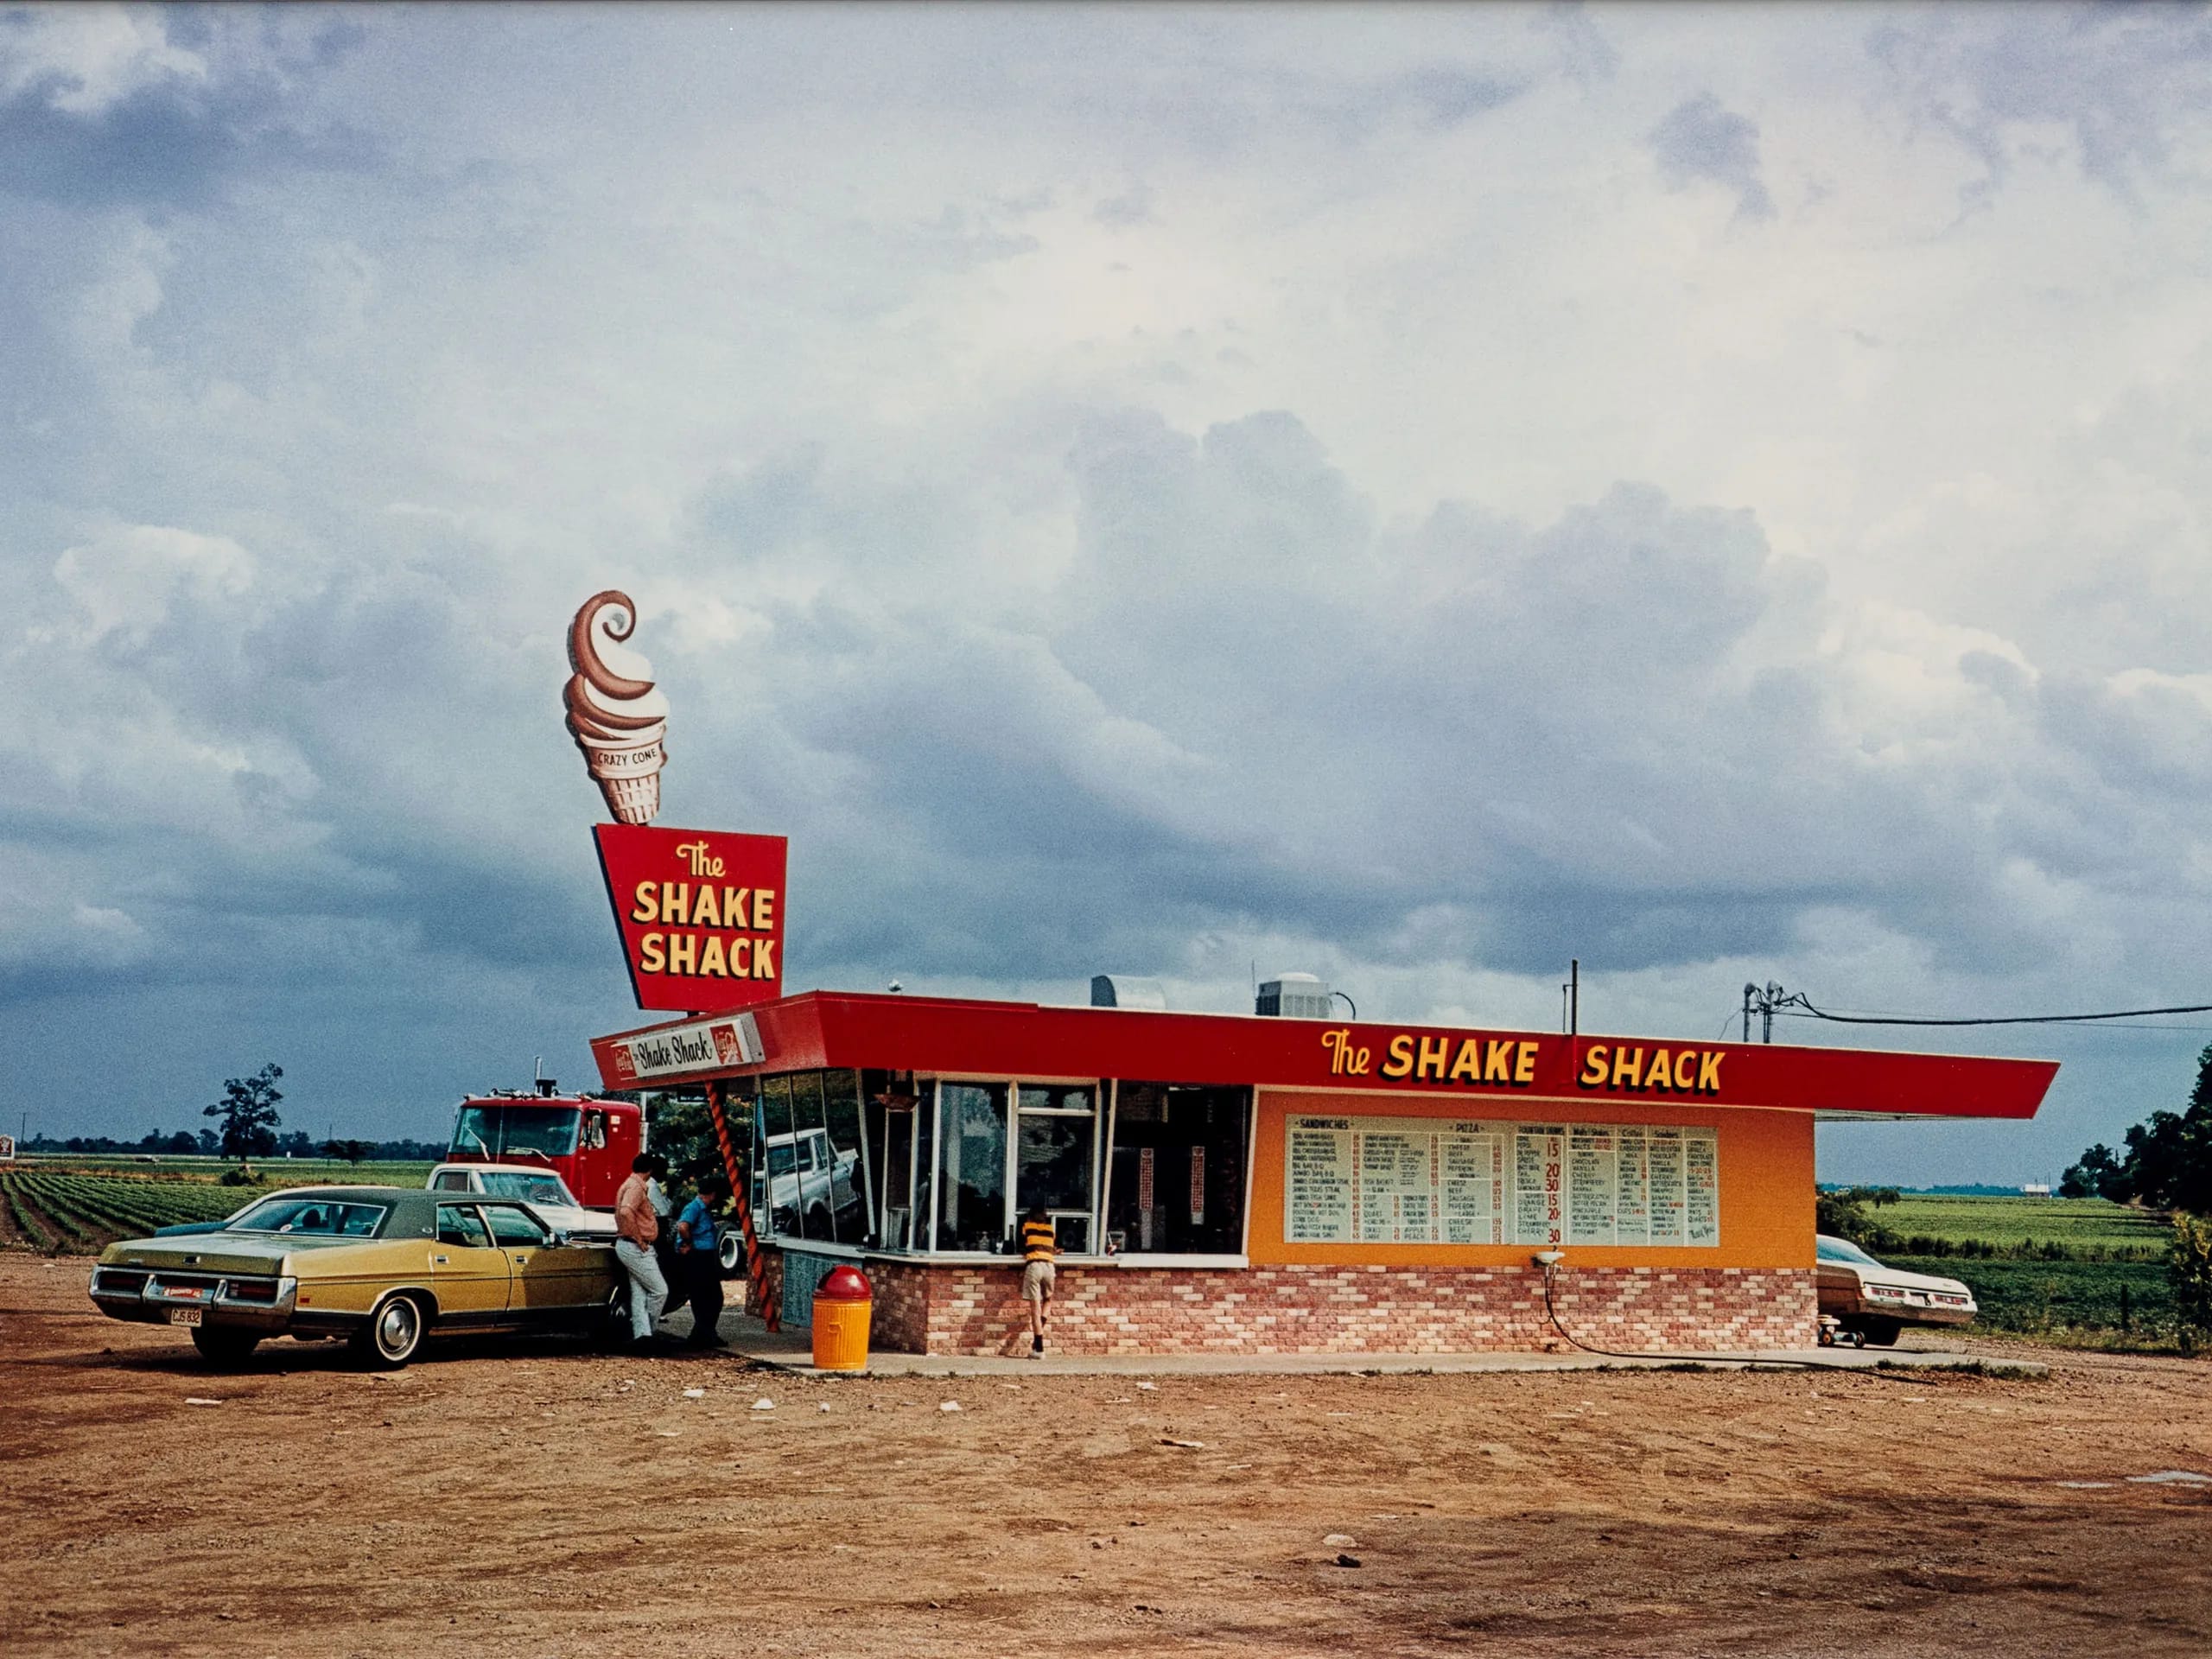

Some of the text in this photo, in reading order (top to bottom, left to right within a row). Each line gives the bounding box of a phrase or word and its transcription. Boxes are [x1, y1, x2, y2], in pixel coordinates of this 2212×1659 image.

[597, 748, 658, 767] CRAZY CONE
[676, 840, 726, 878] The
[631, 880, 775, 931] SHAKE
[639, 932, 775, 980] SHACK
[638, 1041, 671, 1070] Shake
[671, 1032, 712, 1065] Shack
[1321, 1028, 1725, 1095] The SHAKE SHACK
[1300, 1118, 1349, 1129] SANDWICHES
[1546, 1179, 1559, 1192] 30
[1548, 1194, 1558, 1206] 15
[1548, 1229, 1560, 1243] 30
[173, 1310, 200, 1323] CJS 832
